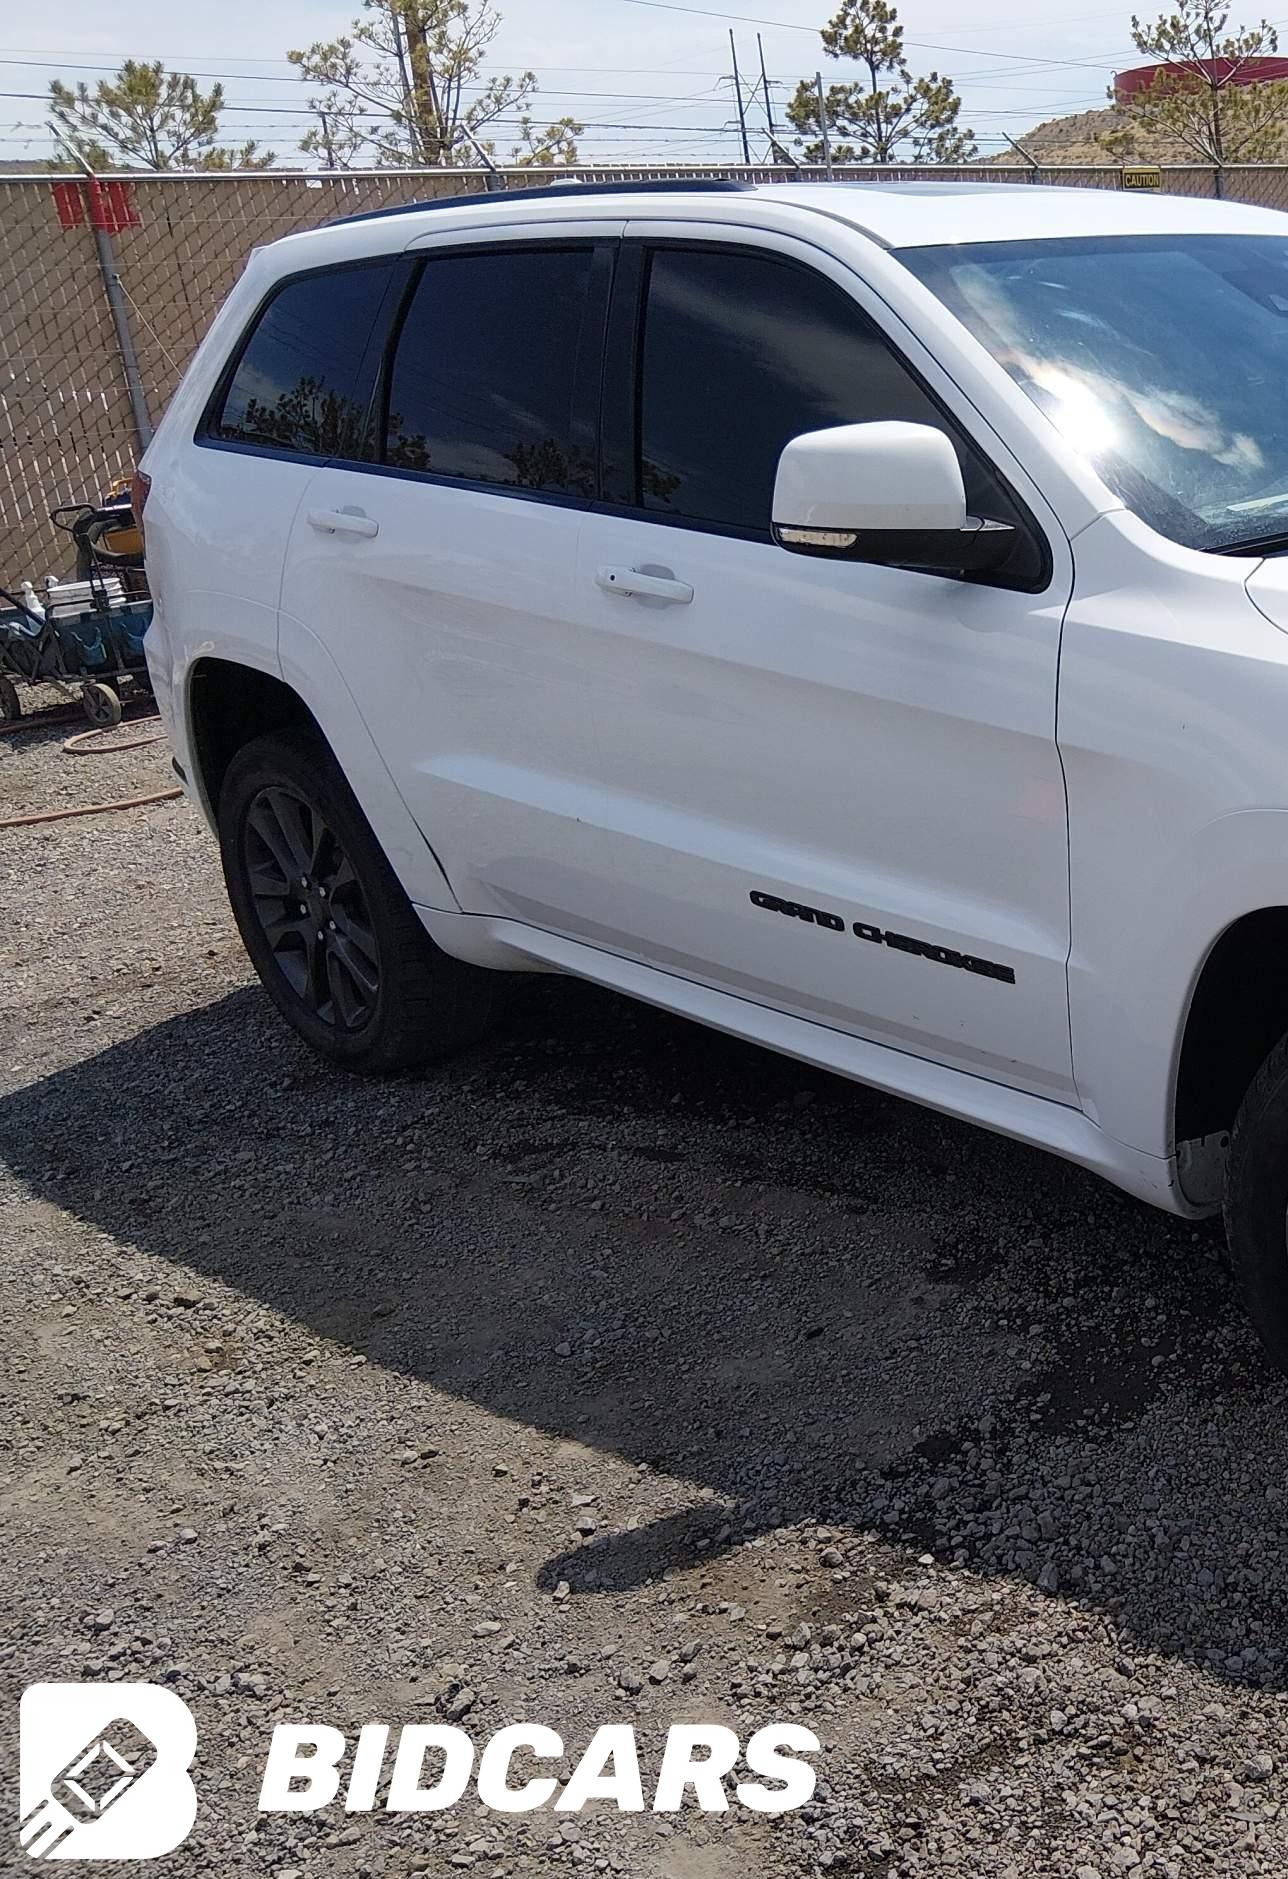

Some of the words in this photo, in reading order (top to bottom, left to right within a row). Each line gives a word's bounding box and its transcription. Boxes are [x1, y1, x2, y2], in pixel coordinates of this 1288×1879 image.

[1125, 174, 1159, 186] CAUTION
[749, 890, 845, 932] GRAND
[853, 921, 1016, 984] CHEROKEE
